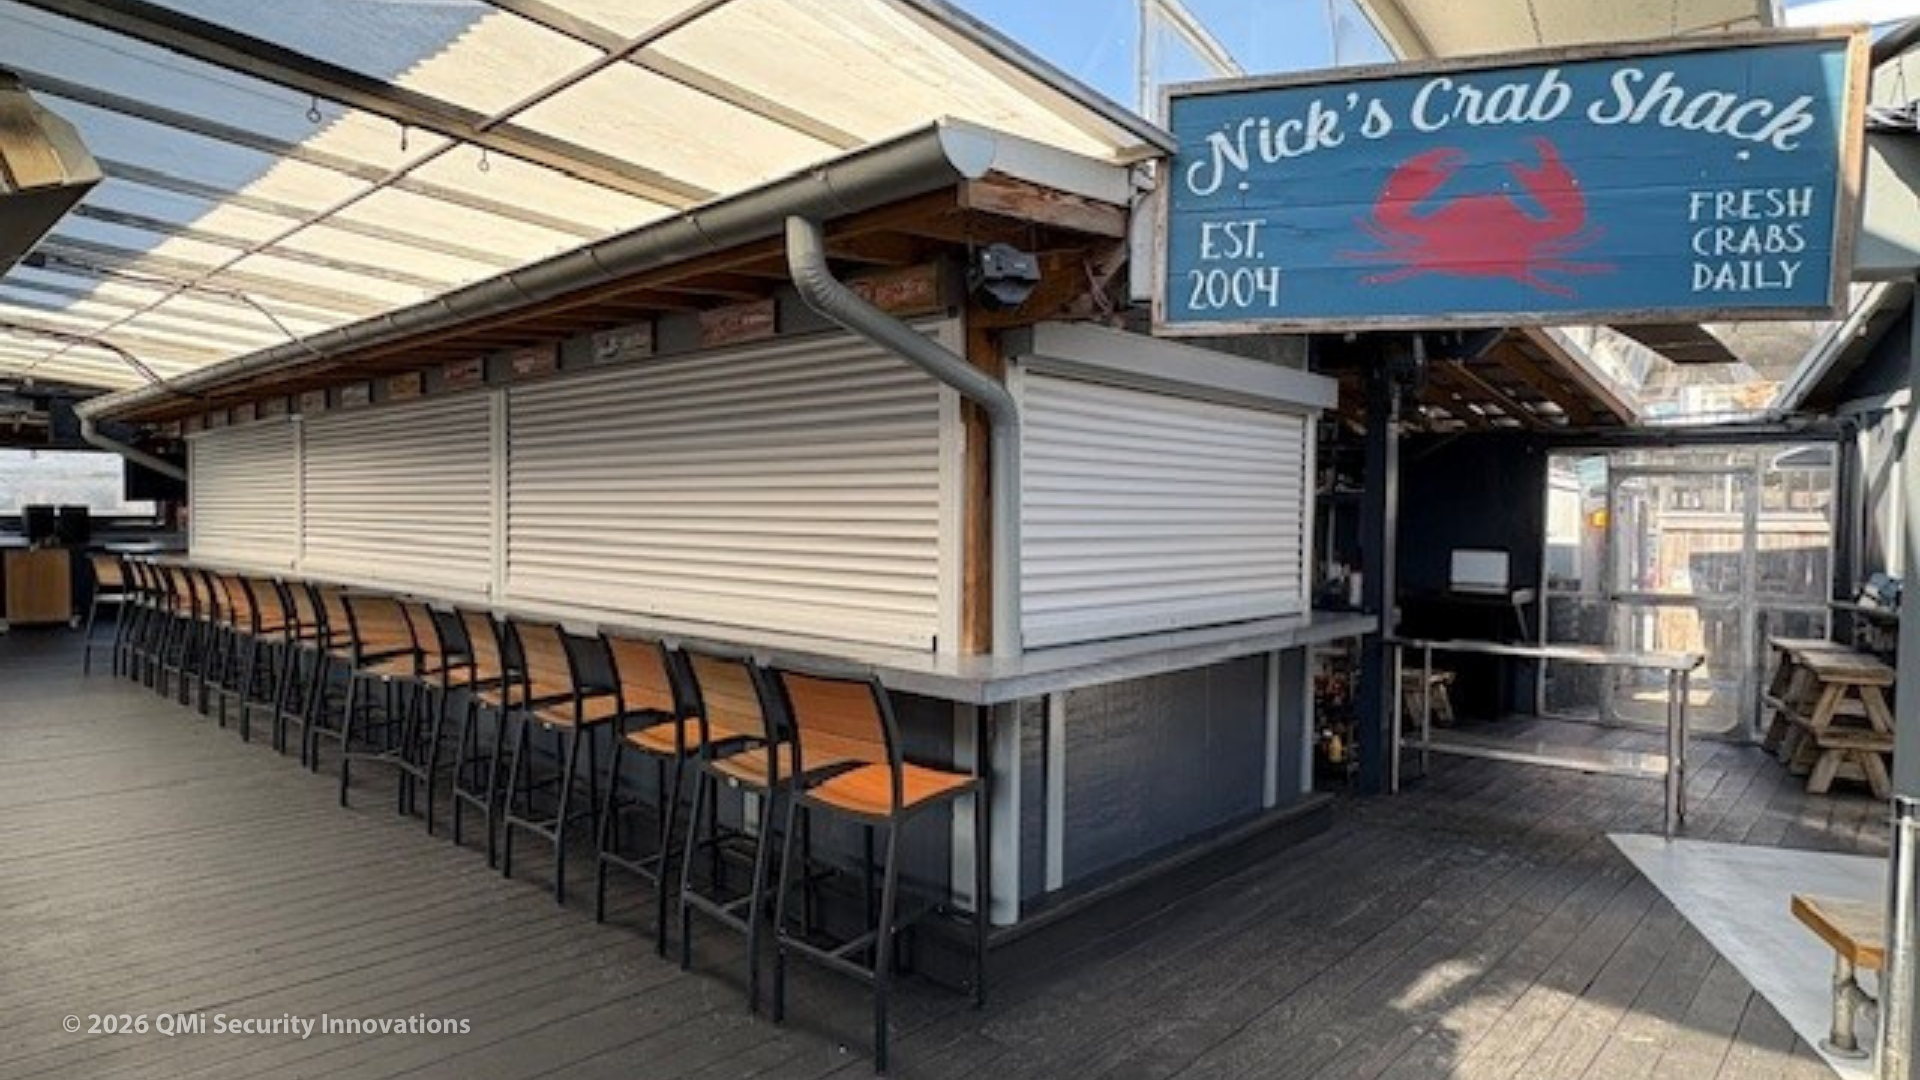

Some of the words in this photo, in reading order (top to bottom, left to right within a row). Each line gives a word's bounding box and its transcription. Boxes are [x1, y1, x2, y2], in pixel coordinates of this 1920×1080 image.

[1187, 92, 1393, 195] Nick's
[1410, 68, 1572, 131] Crab
[1587, 68, 1814, 150] Shack
[1688, 187, 1813, 222] FRESH
[1201, 218, 1267, 260] EST.
[1691, 222, 1805, 256] CRABS
[1188, 265, 1282, 310] 2004
[1692, 260, 1800, 291] DAILY
